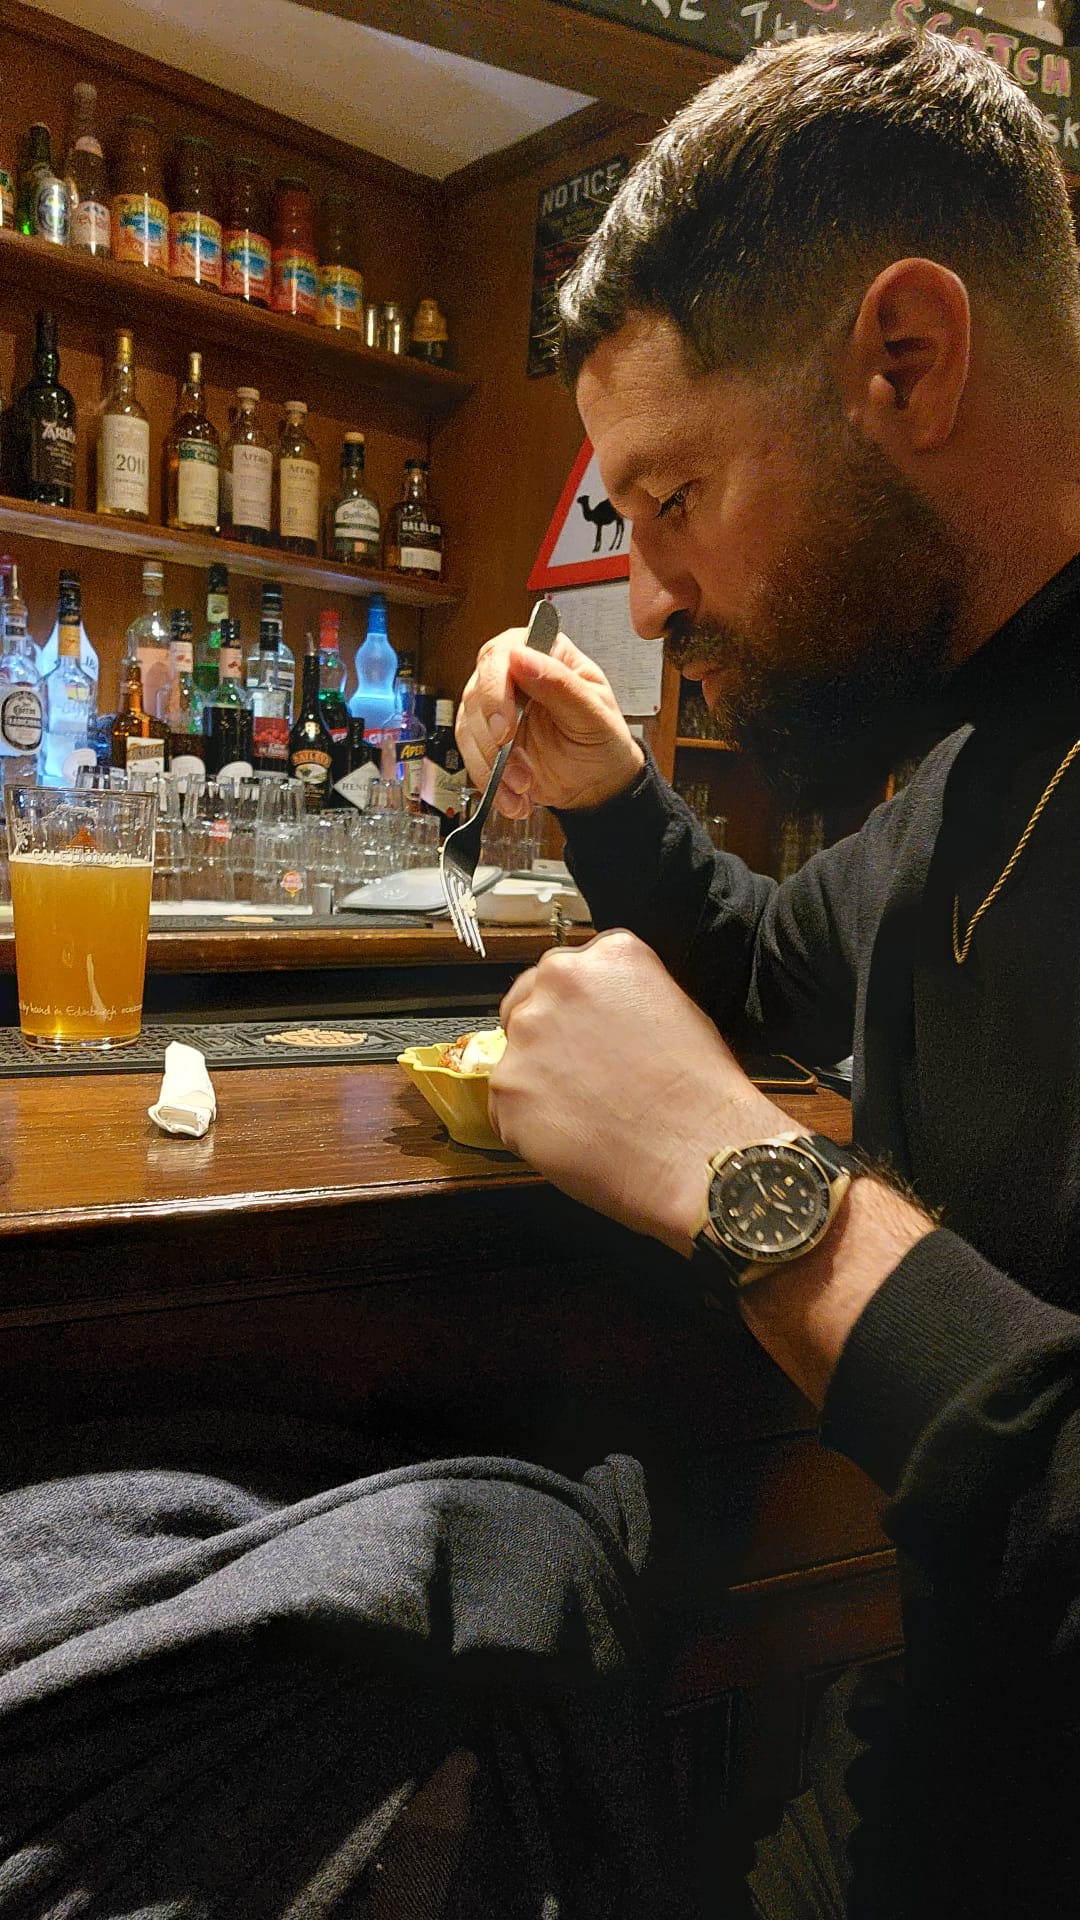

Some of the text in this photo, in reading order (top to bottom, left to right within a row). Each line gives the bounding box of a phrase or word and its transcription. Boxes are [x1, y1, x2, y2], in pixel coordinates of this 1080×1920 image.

[541, 161, 622, 217] NOTICE
[115, 453, 146, 476] 2011
[31, 848, 133, 865] CALEDONIAN
[30, 1002, 51, 1016] hand
[65, 1004, 118, 1021] Edinburgh
